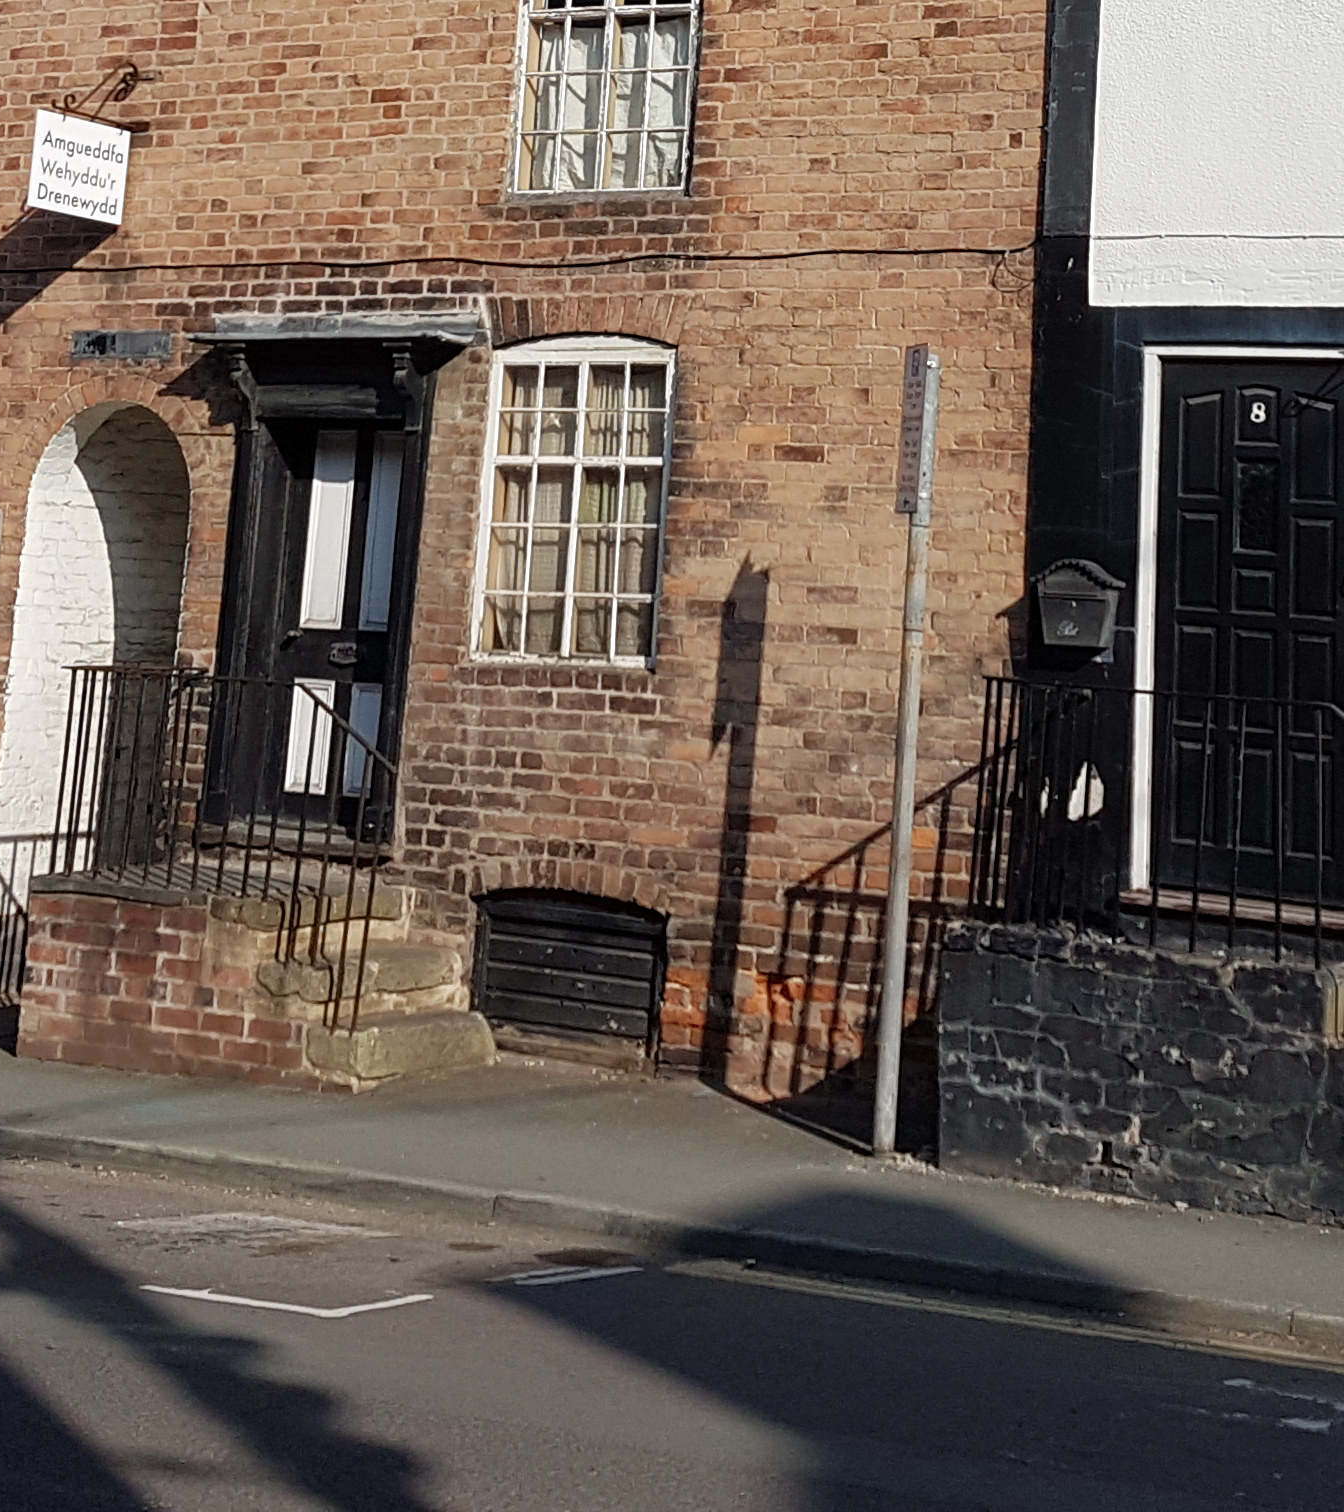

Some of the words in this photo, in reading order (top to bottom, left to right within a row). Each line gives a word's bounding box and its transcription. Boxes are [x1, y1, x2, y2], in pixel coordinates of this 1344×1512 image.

[42, 130, 124, 164] Amgueddfa
[40, 157, 116, 190] Wehyddu'r
[37, 183, 118, 216] Drenewydd
[1250, 402, 1266, 423] 8
